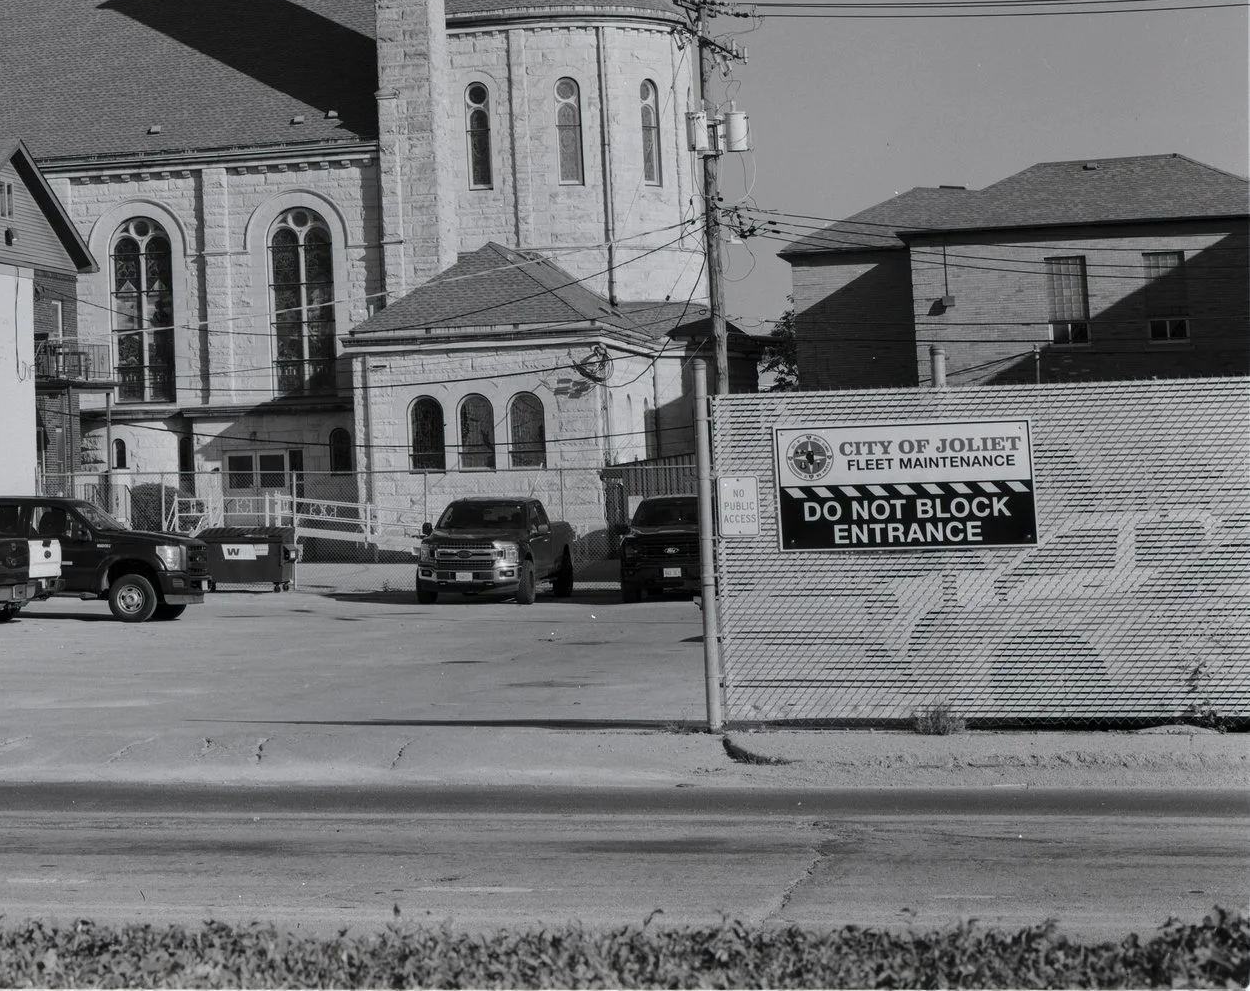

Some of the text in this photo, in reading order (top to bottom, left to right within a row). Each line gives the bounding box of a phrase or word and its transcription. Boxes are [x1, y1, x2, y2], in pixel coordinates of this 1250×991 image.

[839, 436, 1021, 457] CITY OF JOLIET
[847, 455, 1016, 471] FLEET MAINTENANCE
[733, 489, 745, 498] NO
[724, 501, 755, 511] PUBLIC
[804, 496, 1012, 522] DO NOT BLOCK
[724, 514, 757, 523] ACCESS
[834, 521, 983, 544] ENTRANCE
